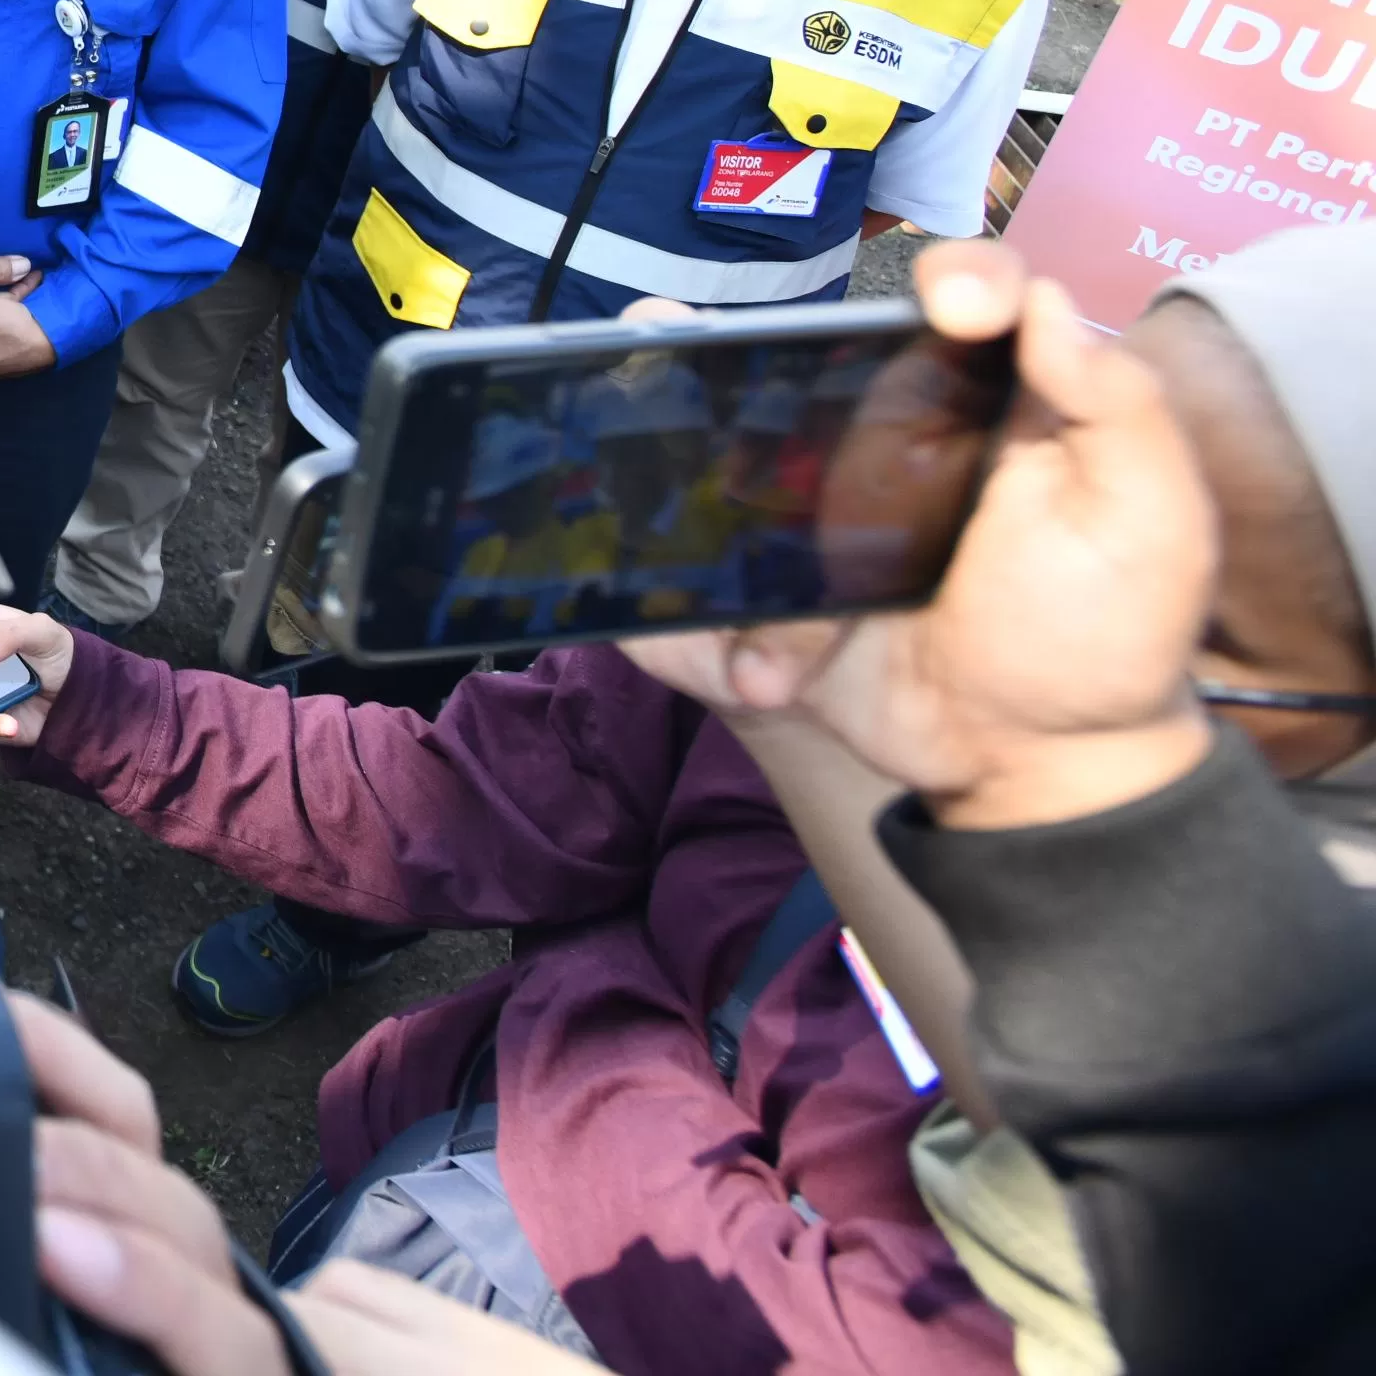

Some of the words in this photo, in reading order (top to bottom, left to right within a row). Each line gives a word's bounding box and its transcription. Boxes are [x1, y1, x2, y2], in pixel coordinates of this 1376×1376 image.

[854, 39, 902, 70] ESDM
[859, 31, 902, 52] KEMENTERIAN
[1195, 107, 1261, 147] PT
[718, 168, 736, 176] ZONA
[720, 155, 762, 169] VISITOR
[711, 187, 740, 197] 00048
[1144, 135, 1369, 225] Regional
[1126, 225, 1232, 274] Me
